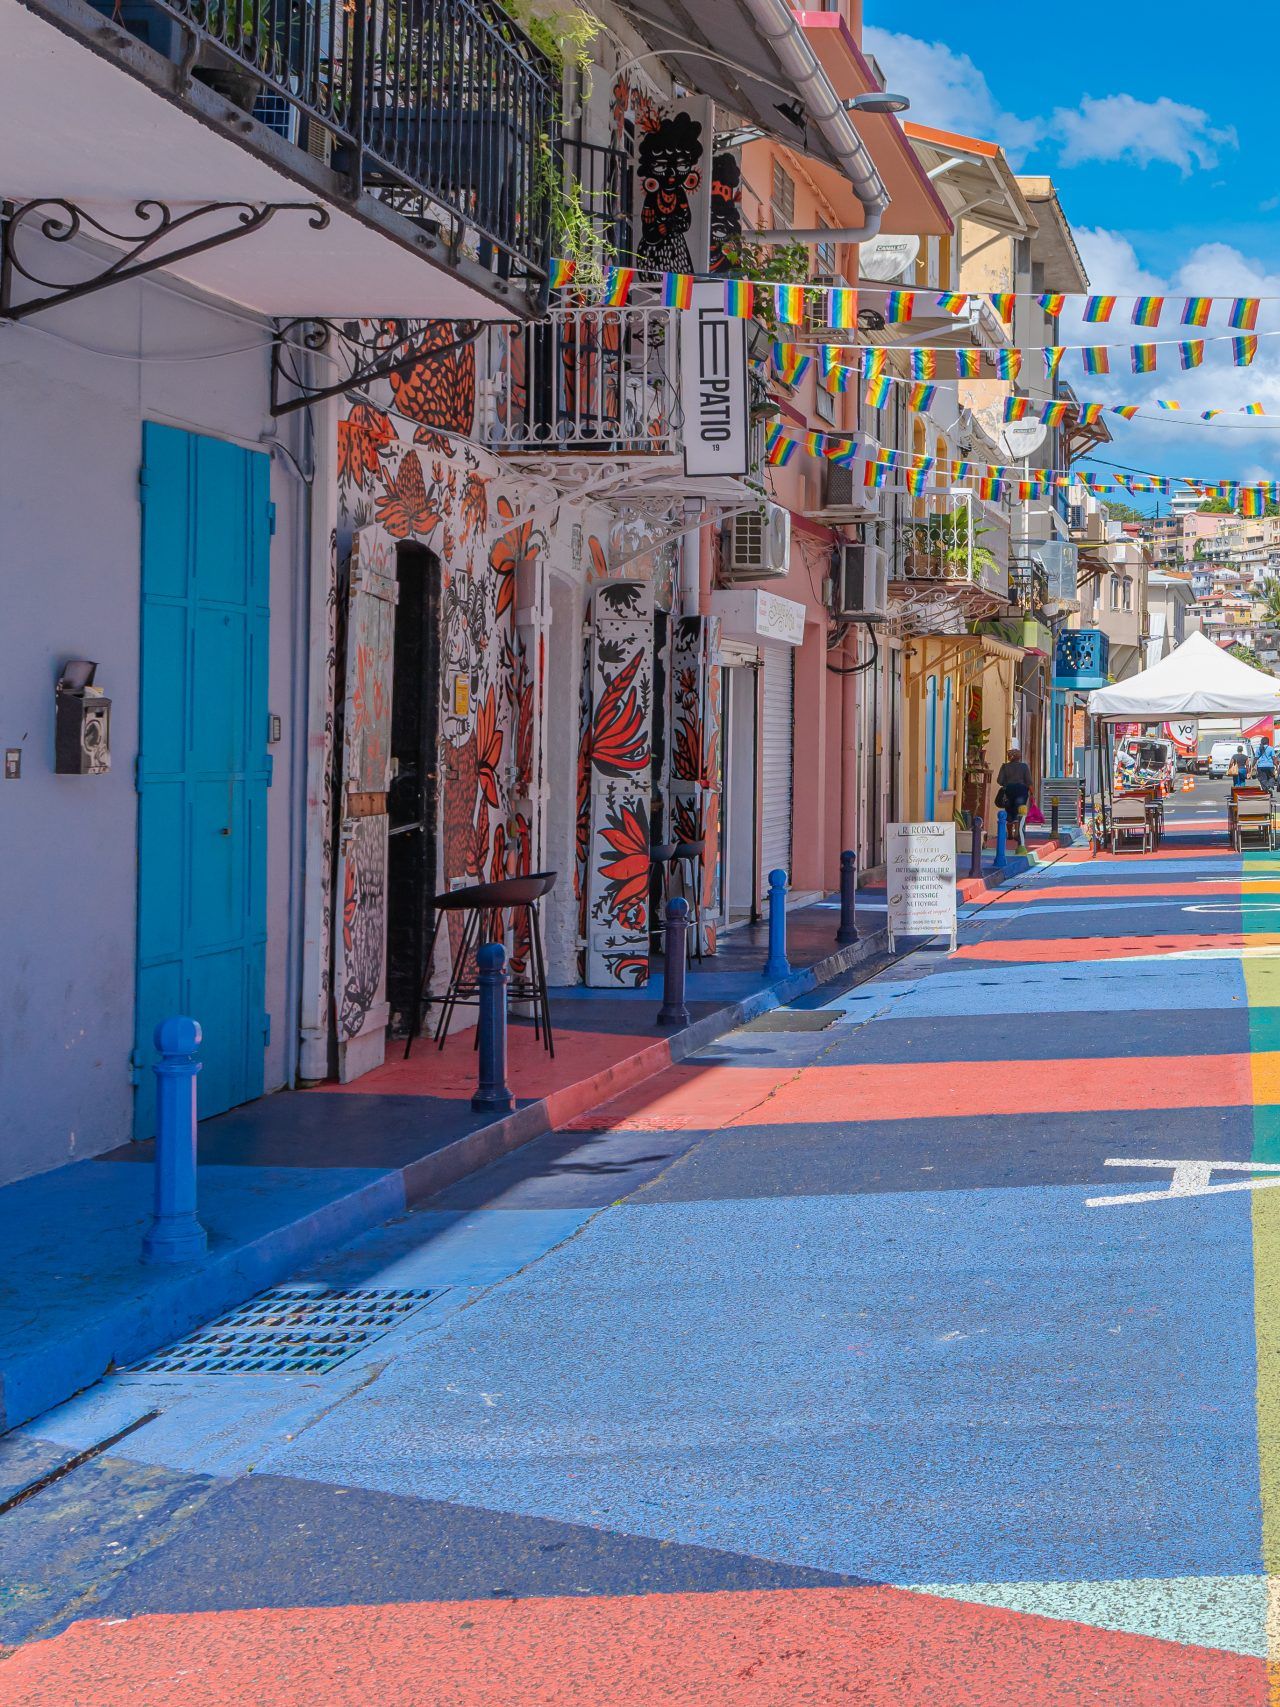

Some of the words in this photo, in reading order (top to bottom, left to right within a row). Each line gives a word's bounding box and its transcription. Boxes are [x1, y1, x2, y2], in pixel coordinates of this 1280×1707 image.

[699, 307, 730, 379] LE
[700, 379, 731, 442] PATIO
[712, 444, 720, 452] 19
[911, 825, 941, 834] RODNEY
[893, 855, 904, 864] Le
[907, 855, 928, 866] Signe
[931, 854, 952, 863] d'Or
